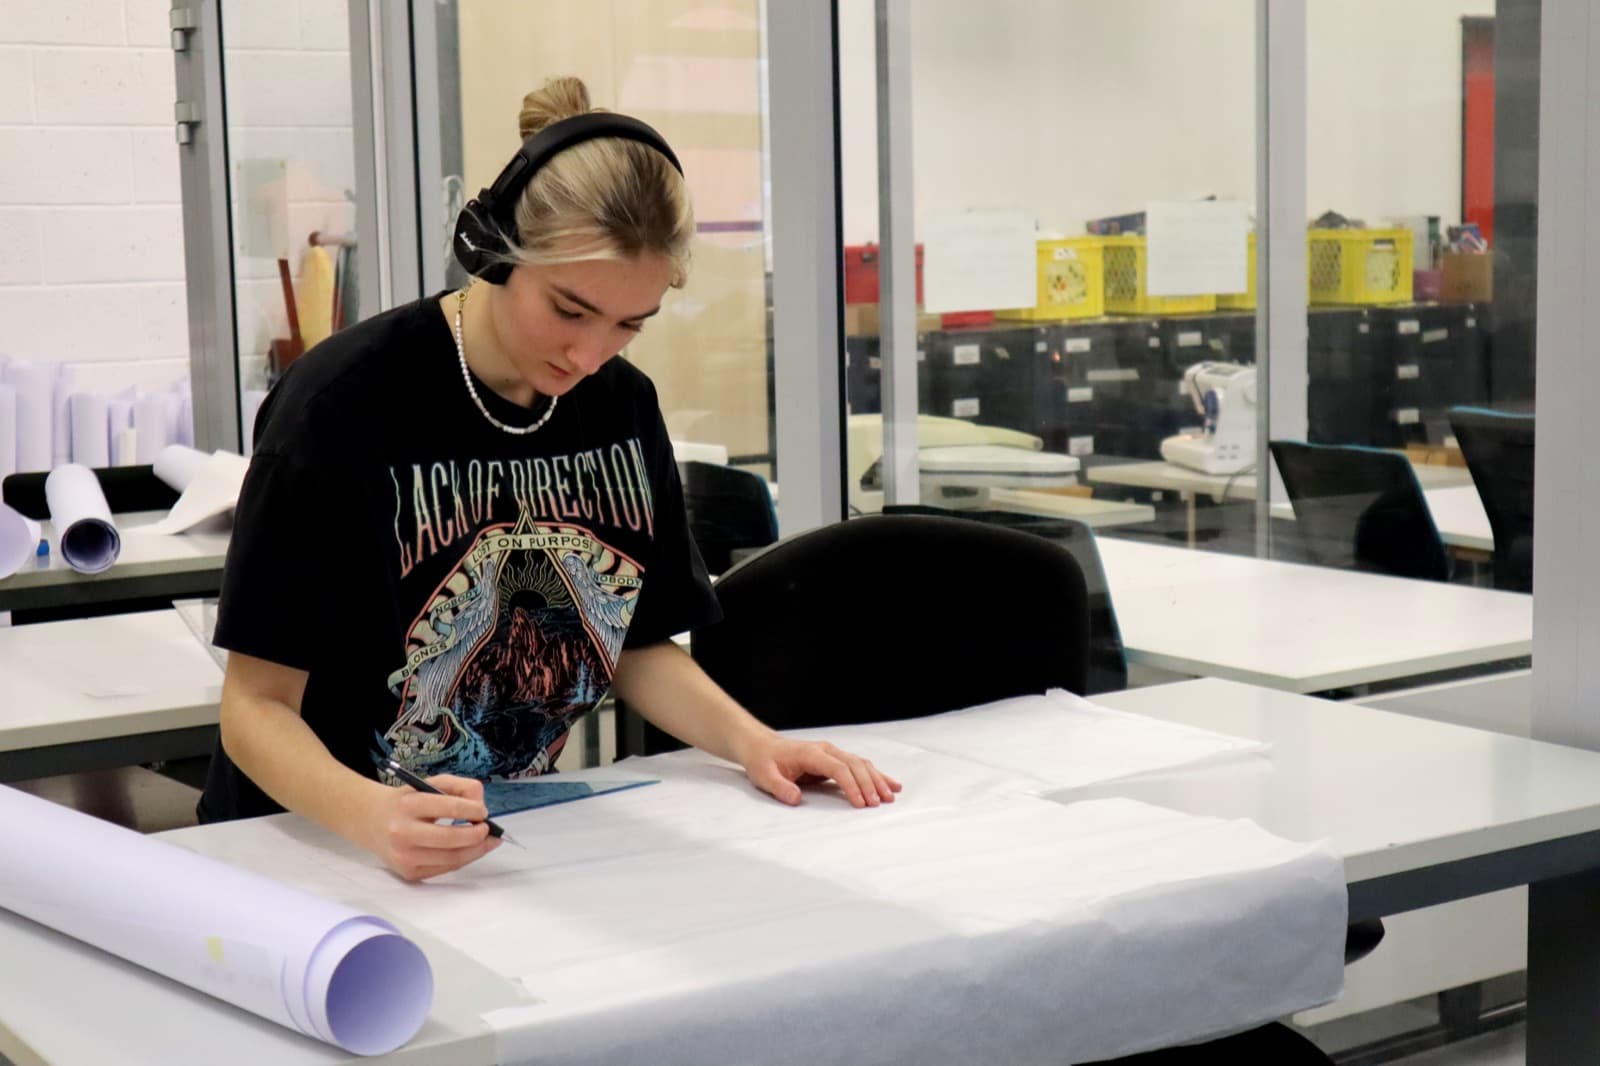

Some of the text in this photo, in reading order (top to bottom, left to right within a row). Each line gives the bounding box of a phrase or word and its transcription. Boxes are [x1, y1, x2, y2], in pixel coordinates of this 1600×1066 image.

[389, 437, 654, 579] LACK OF DIRECTION
[472, 536, 593, 563] LOST ON PURPOSE
[594, 573, 641, 586] NOBODY
[435, 588, 479, 613] NOBODY
